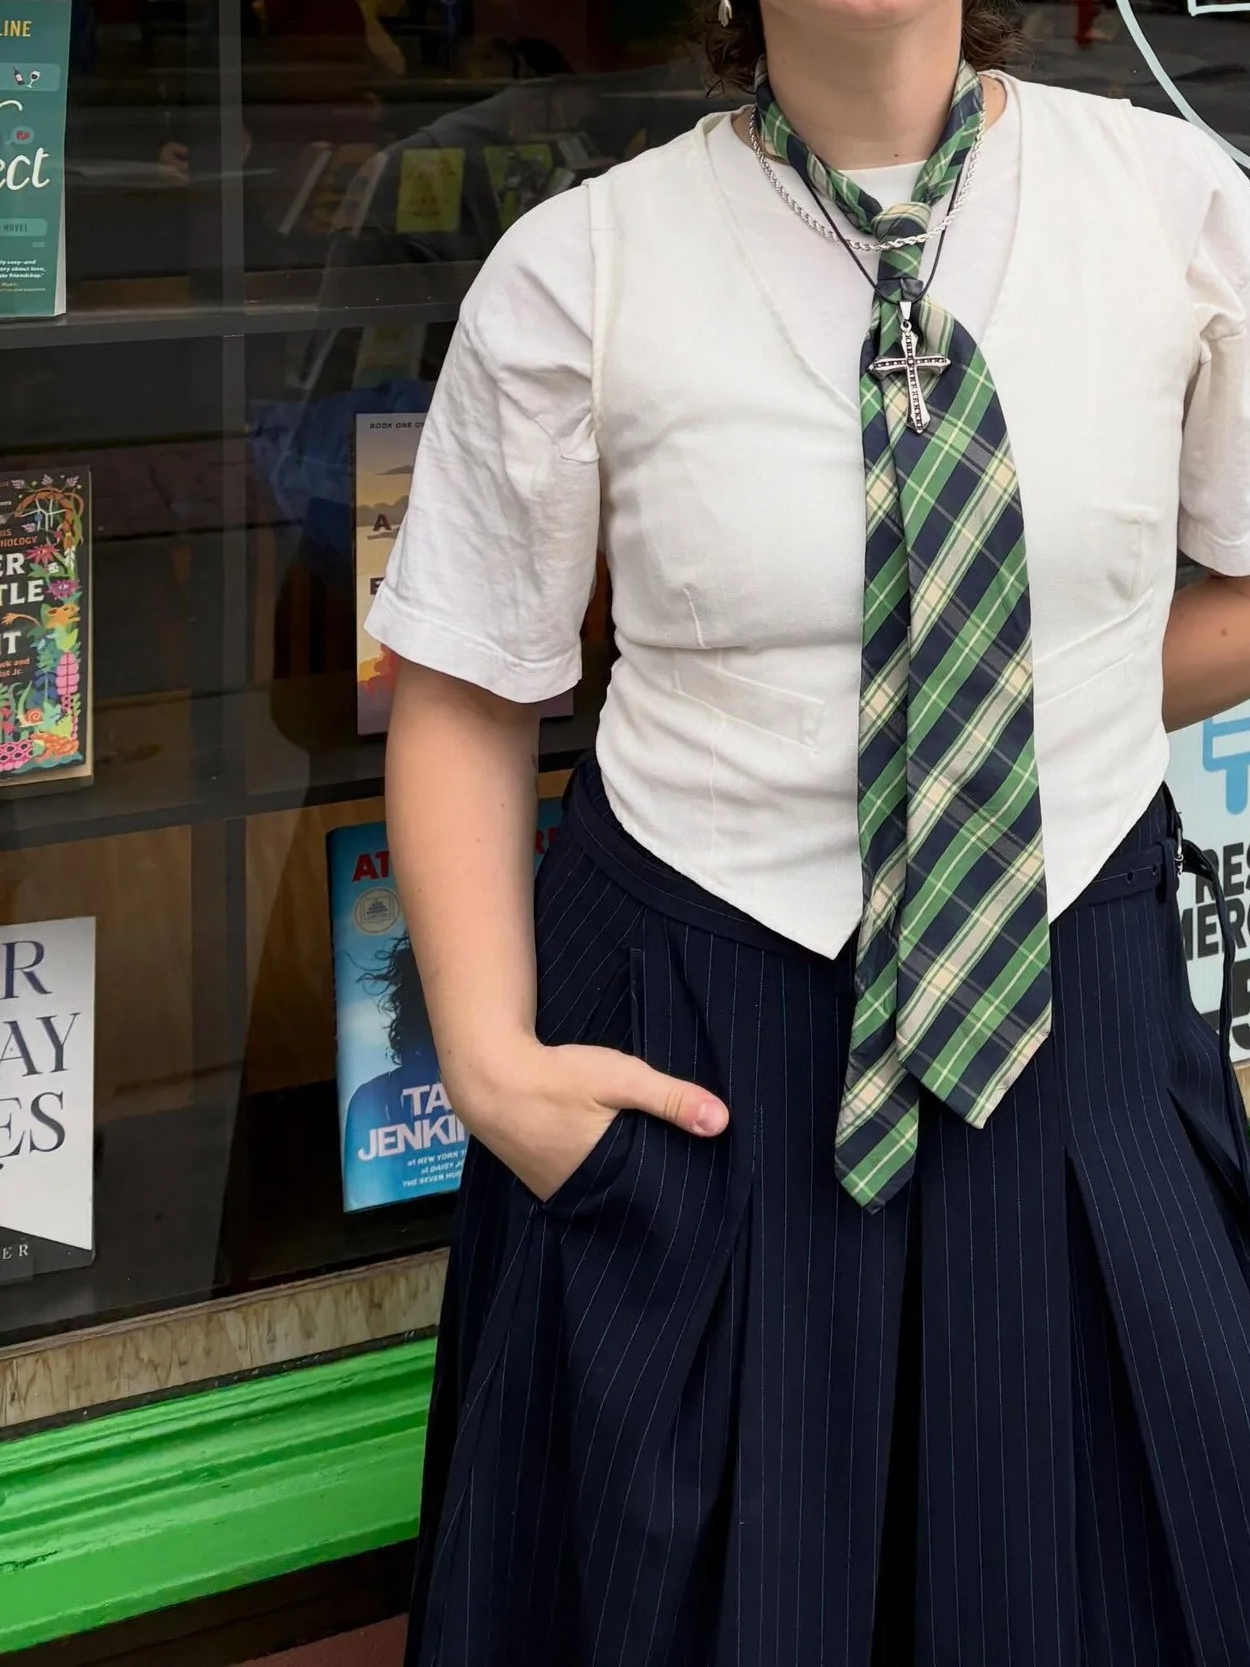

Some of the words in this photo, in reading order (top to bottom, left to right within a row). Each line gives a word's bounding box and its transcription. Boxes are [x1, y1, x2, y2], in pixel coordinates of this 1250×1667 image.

[0, 20, 32, 37] INE
[0, 147, 50, 191] ct
[0, 552, 26, 577] R
